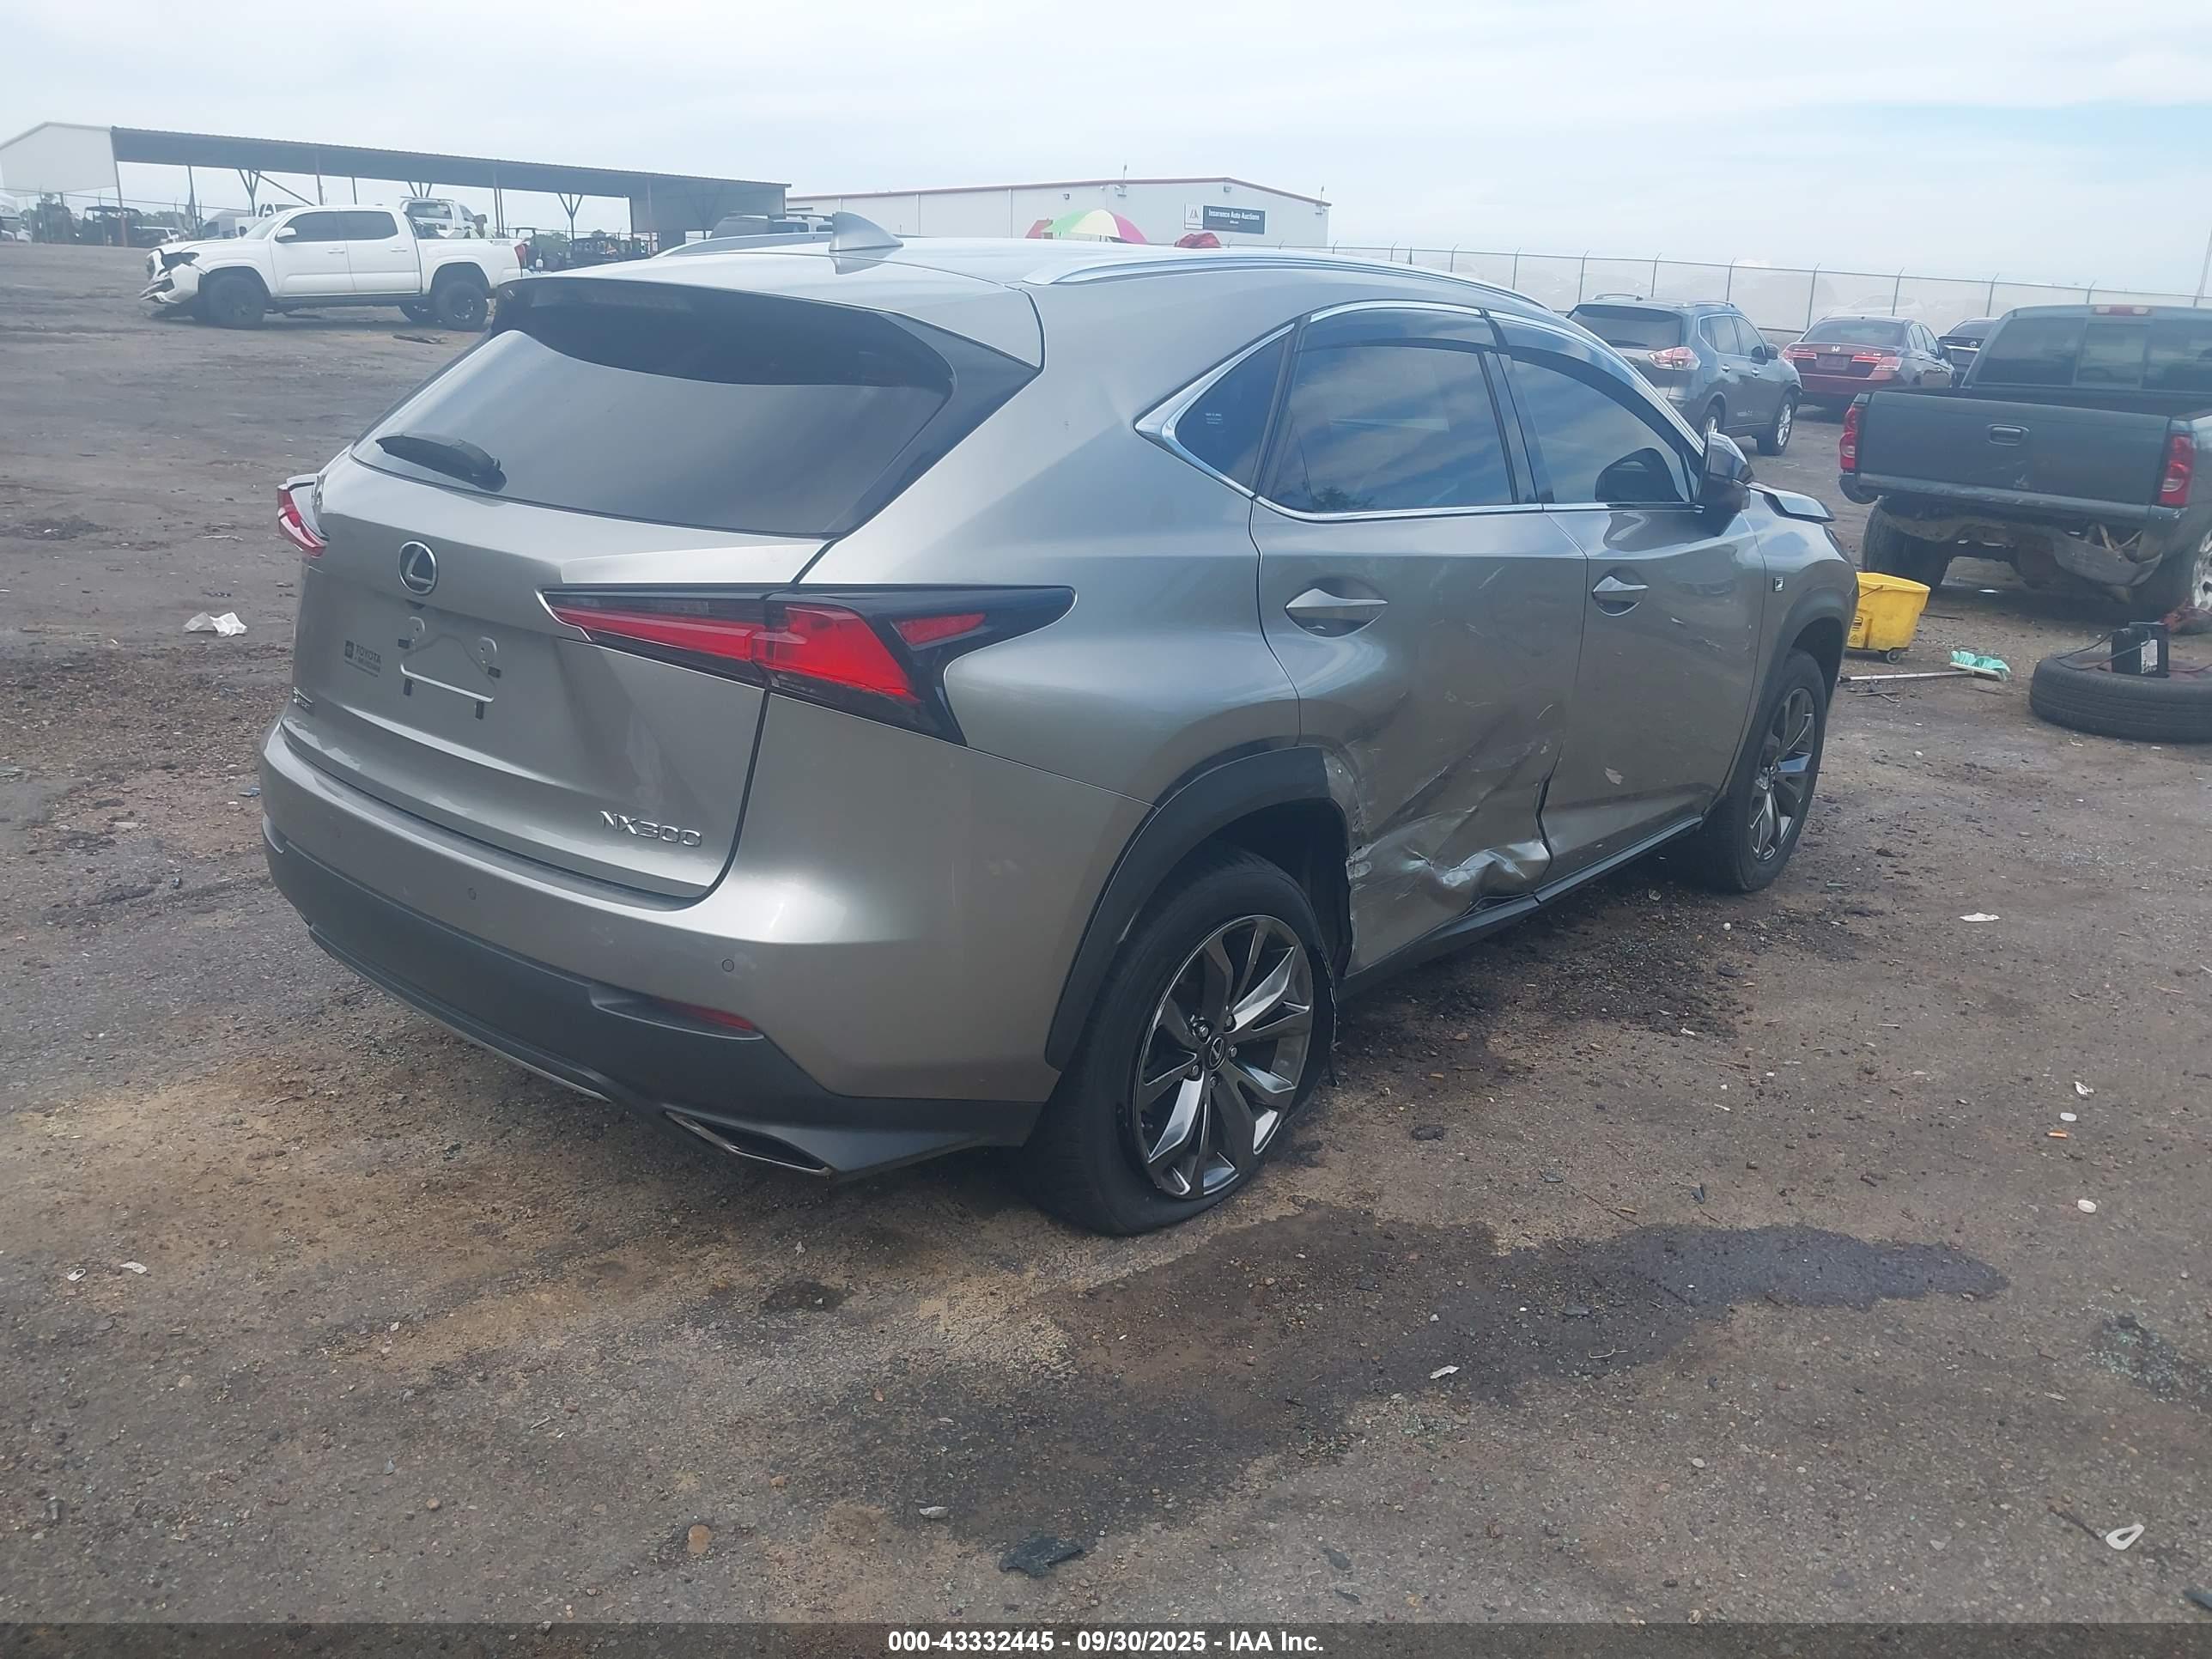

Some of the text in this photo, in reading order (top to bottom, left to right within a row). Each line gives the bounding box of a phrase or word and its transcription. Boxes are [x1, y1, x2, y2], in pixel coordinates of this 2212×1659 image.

[1242, 212, 1260, 221] Auctions
[356, 644, 382, 665] TOYOTA
[599, 810, 702, 848] NX300
